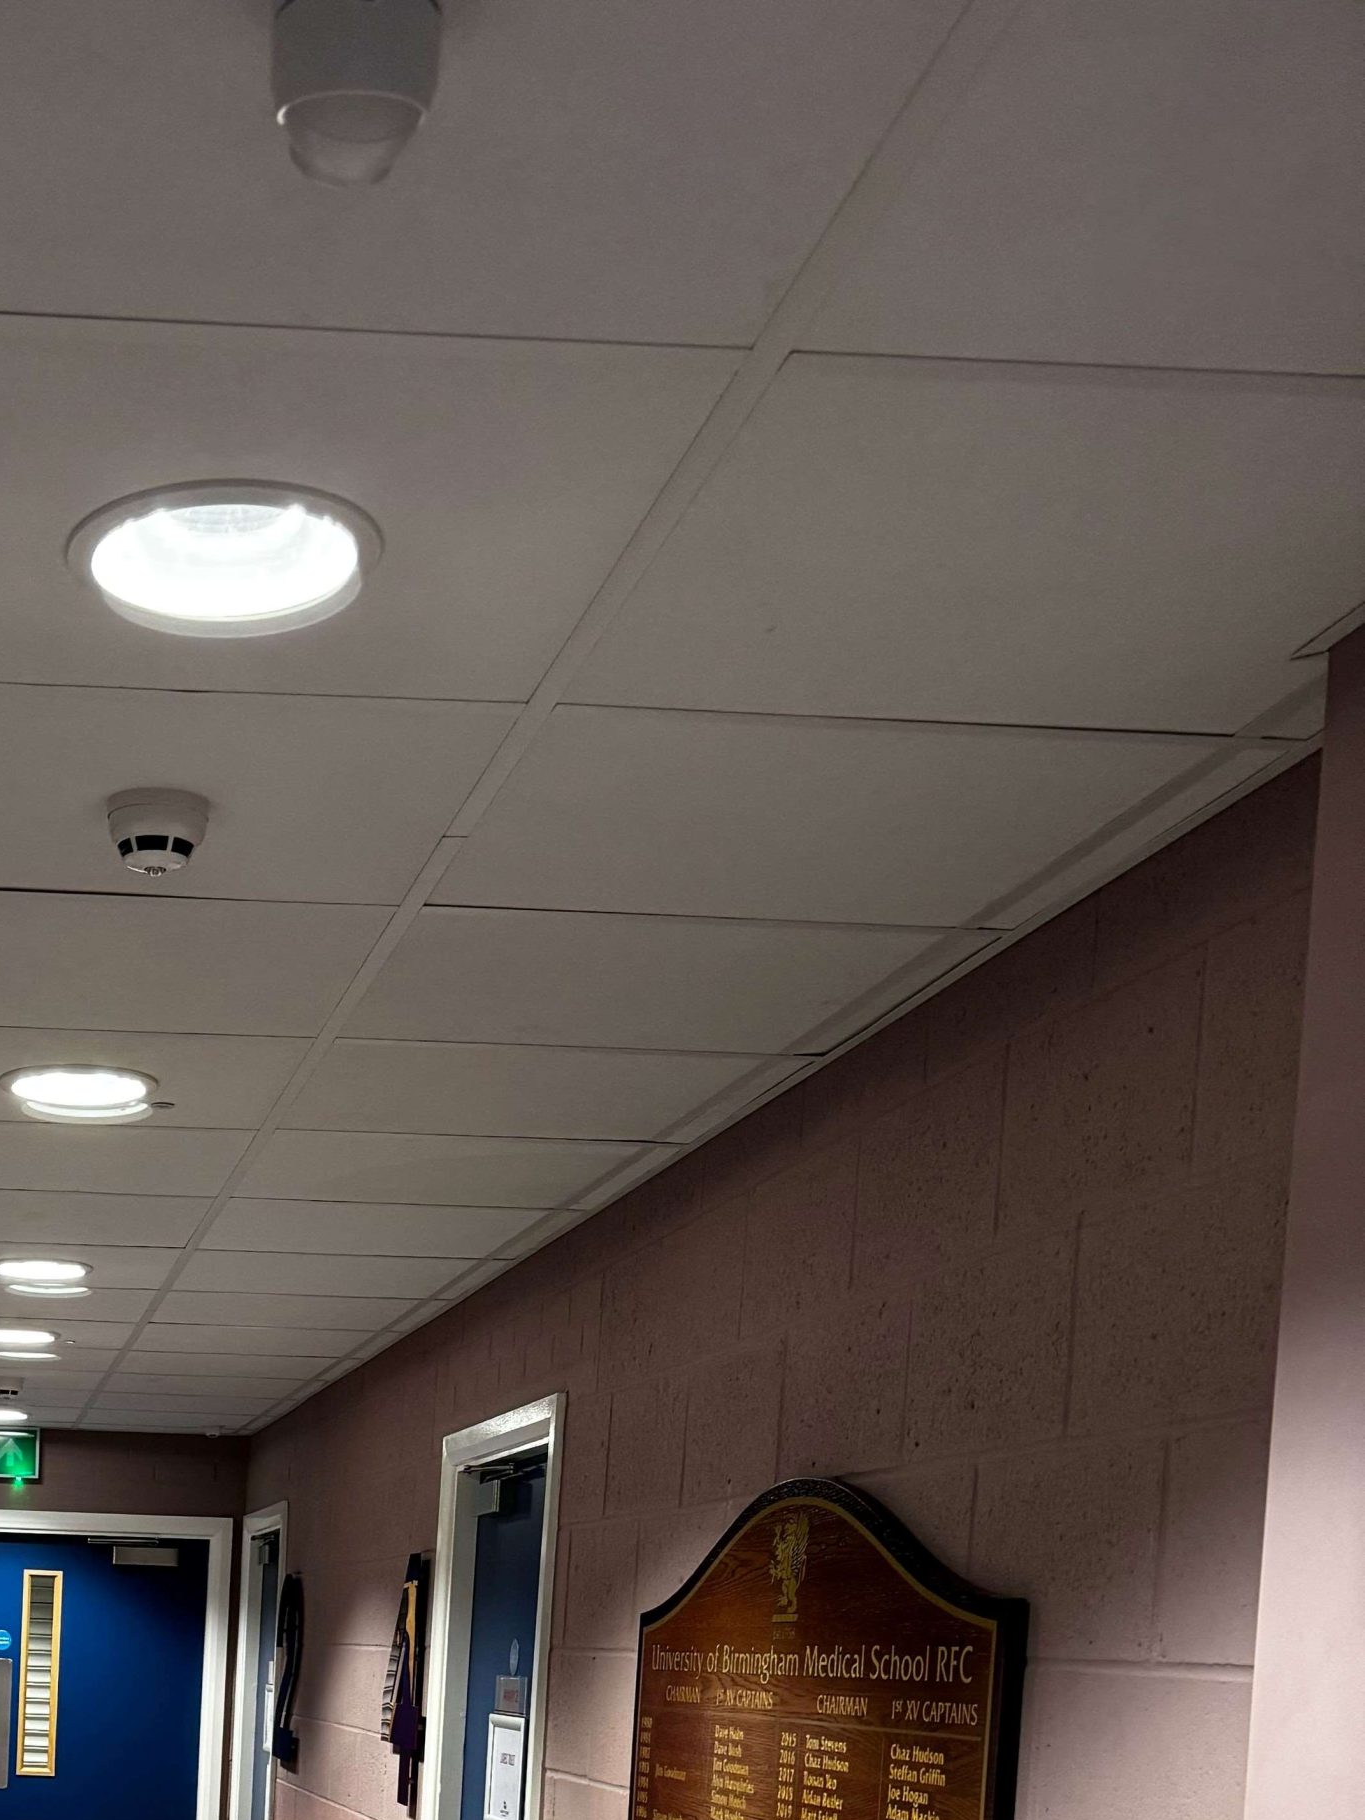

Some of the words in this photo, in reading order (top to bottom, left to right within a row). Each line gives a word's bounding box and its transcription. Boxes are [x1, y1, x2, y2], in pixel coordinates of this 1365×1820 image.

[652, 1644, 704, 1679] University
[707, 1644, 720, 1673] of
[722, 1644, 799, 1684] Birmingham
[803, 1644, 866, 1679] Medical
[869, 1644, 930, 1681] School
[936, 1645, 973, 1684] RFC
[666, 1684, 700, 1703] CHAIRMAN
[736, 1690, 774, 1710] CAPTAINS
[816, 1694, 868, 1717] CHAIRMAN
[891, 1700, 903, 1719] 1st
[905, 1700, 921, 1721] XV
[922, 1701, 978, 1726] CAPTAINS
[806, 1734, 819, 1750] Tom
[821, 1735, 847, 1753] Stevens
[805, 1753, 821, 1768] Chaz
[823, 1756, 849, 1773] Hudson
[891, 1744, 910, 1760] Chaz
[912, 1745, 945, 1765] Hudson
[779, 1768, 795, 1783] 2017
[889, 1763, 917, 1783] Steffan
[919, 1767, 946, 1787] Griffin
[887, 1784, 901, 1802] Joe
[903, 1786, 929, 1807] Hogan
